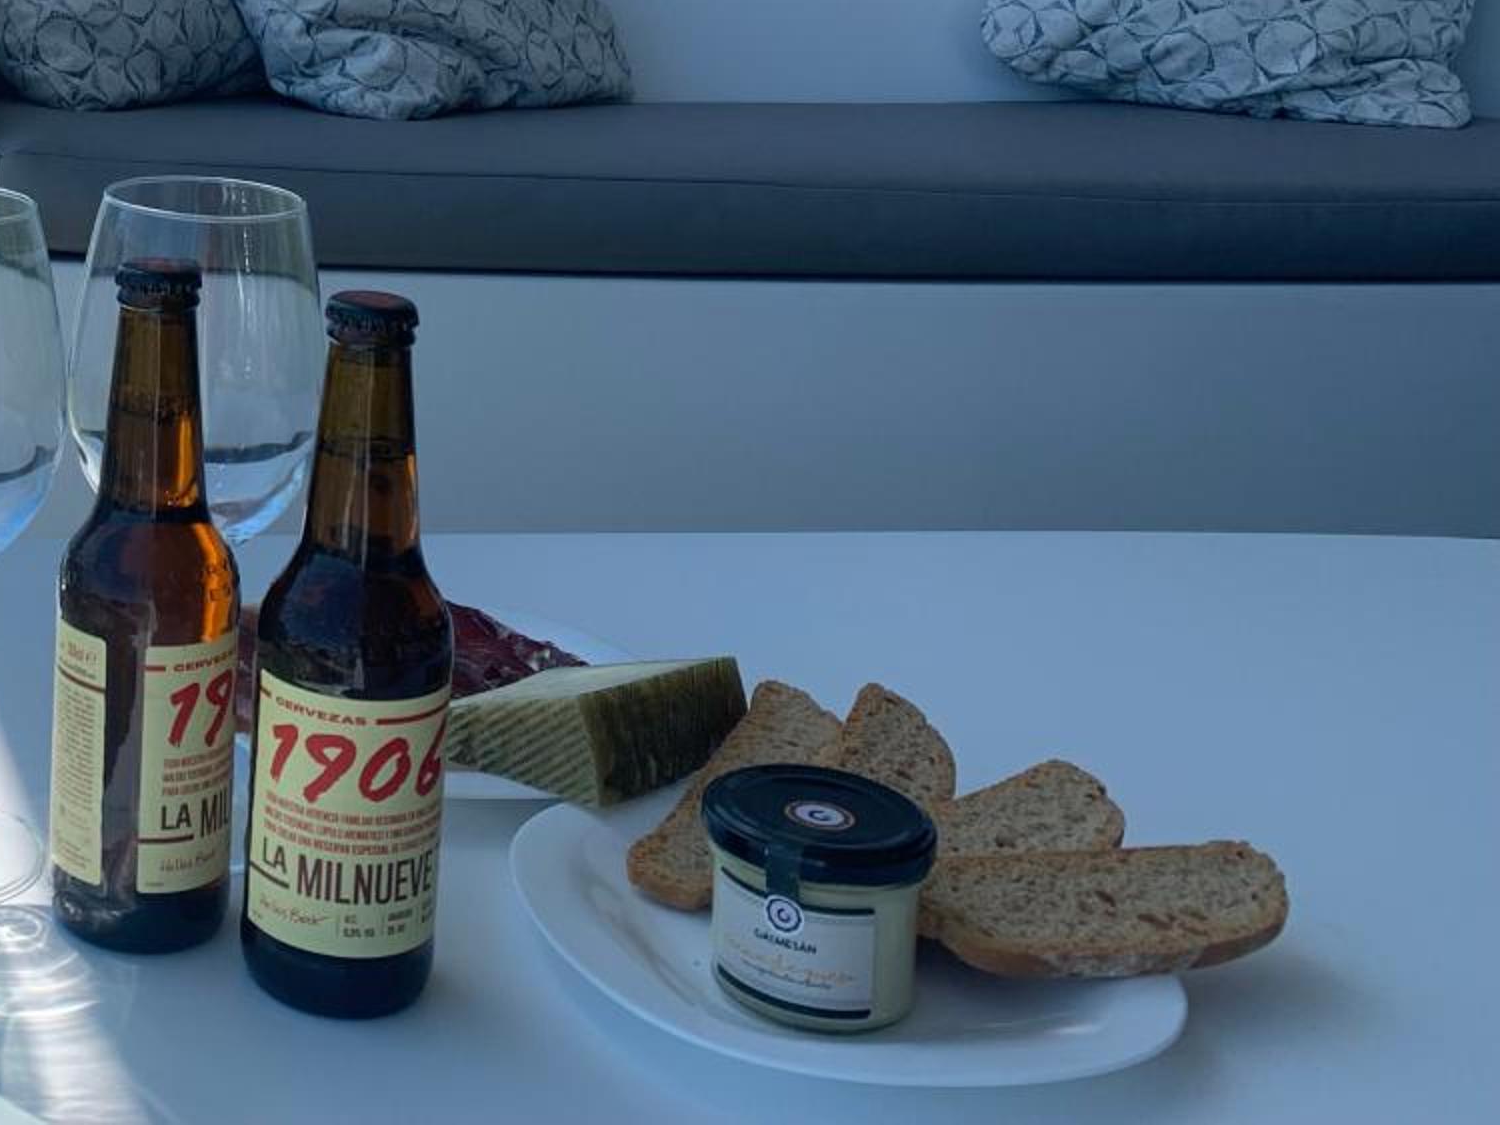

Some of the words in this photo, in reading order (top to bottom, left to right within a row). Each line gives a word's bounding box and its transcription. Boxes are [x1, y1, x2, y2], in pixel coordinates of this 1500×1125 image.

[167, 666, 233, 747] 19
[275, 696, 367, 726] CERVEZAS
[270, 713, 446, 803] 1906
[161, 803, 192, 830] LA
[200, 786, 229, 838] MIL
[262, 836, 288, 875] LA
[296, 848, 433, 906] MILNUEVE
